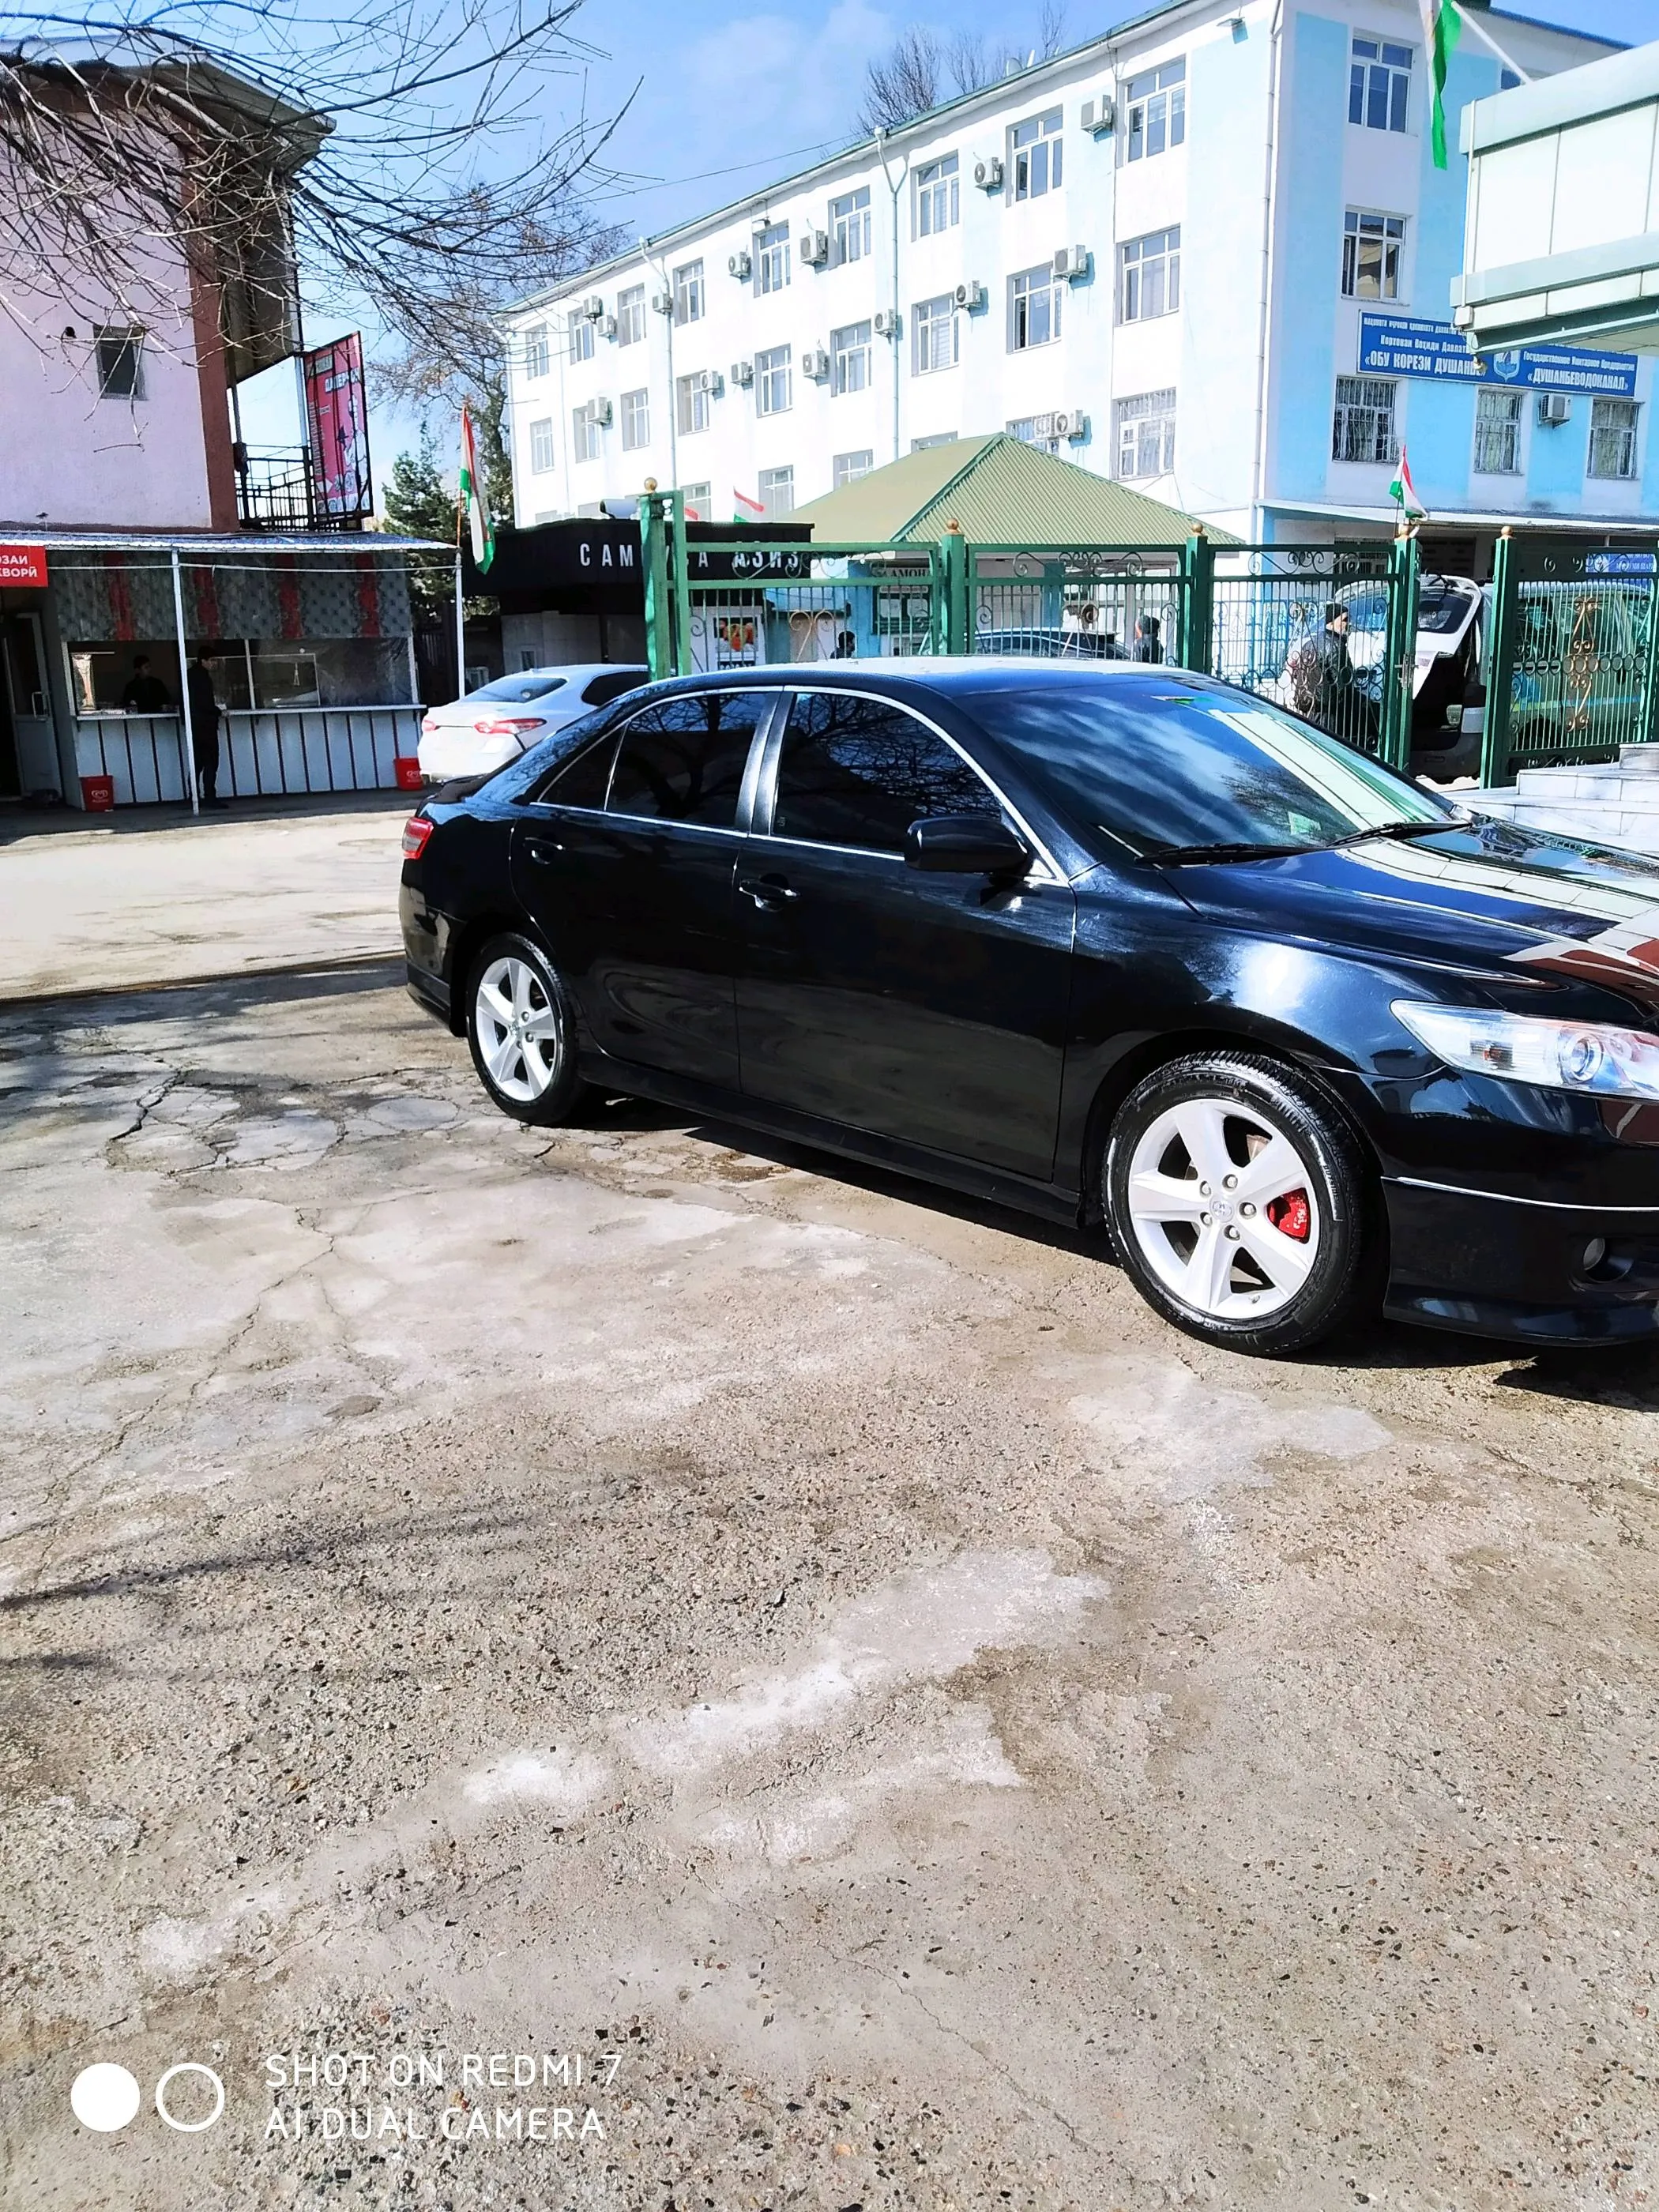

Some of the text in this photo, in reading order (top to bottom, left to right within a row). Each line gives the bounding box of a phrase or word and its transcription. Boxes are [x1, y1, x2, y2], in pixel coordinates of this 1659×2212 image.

[1364, 350, 1390, 367] «ОБУ
[1394, 352, 1431, 371] КОРЕЗИ
[0, 555, 28, 565] ЗАИ
